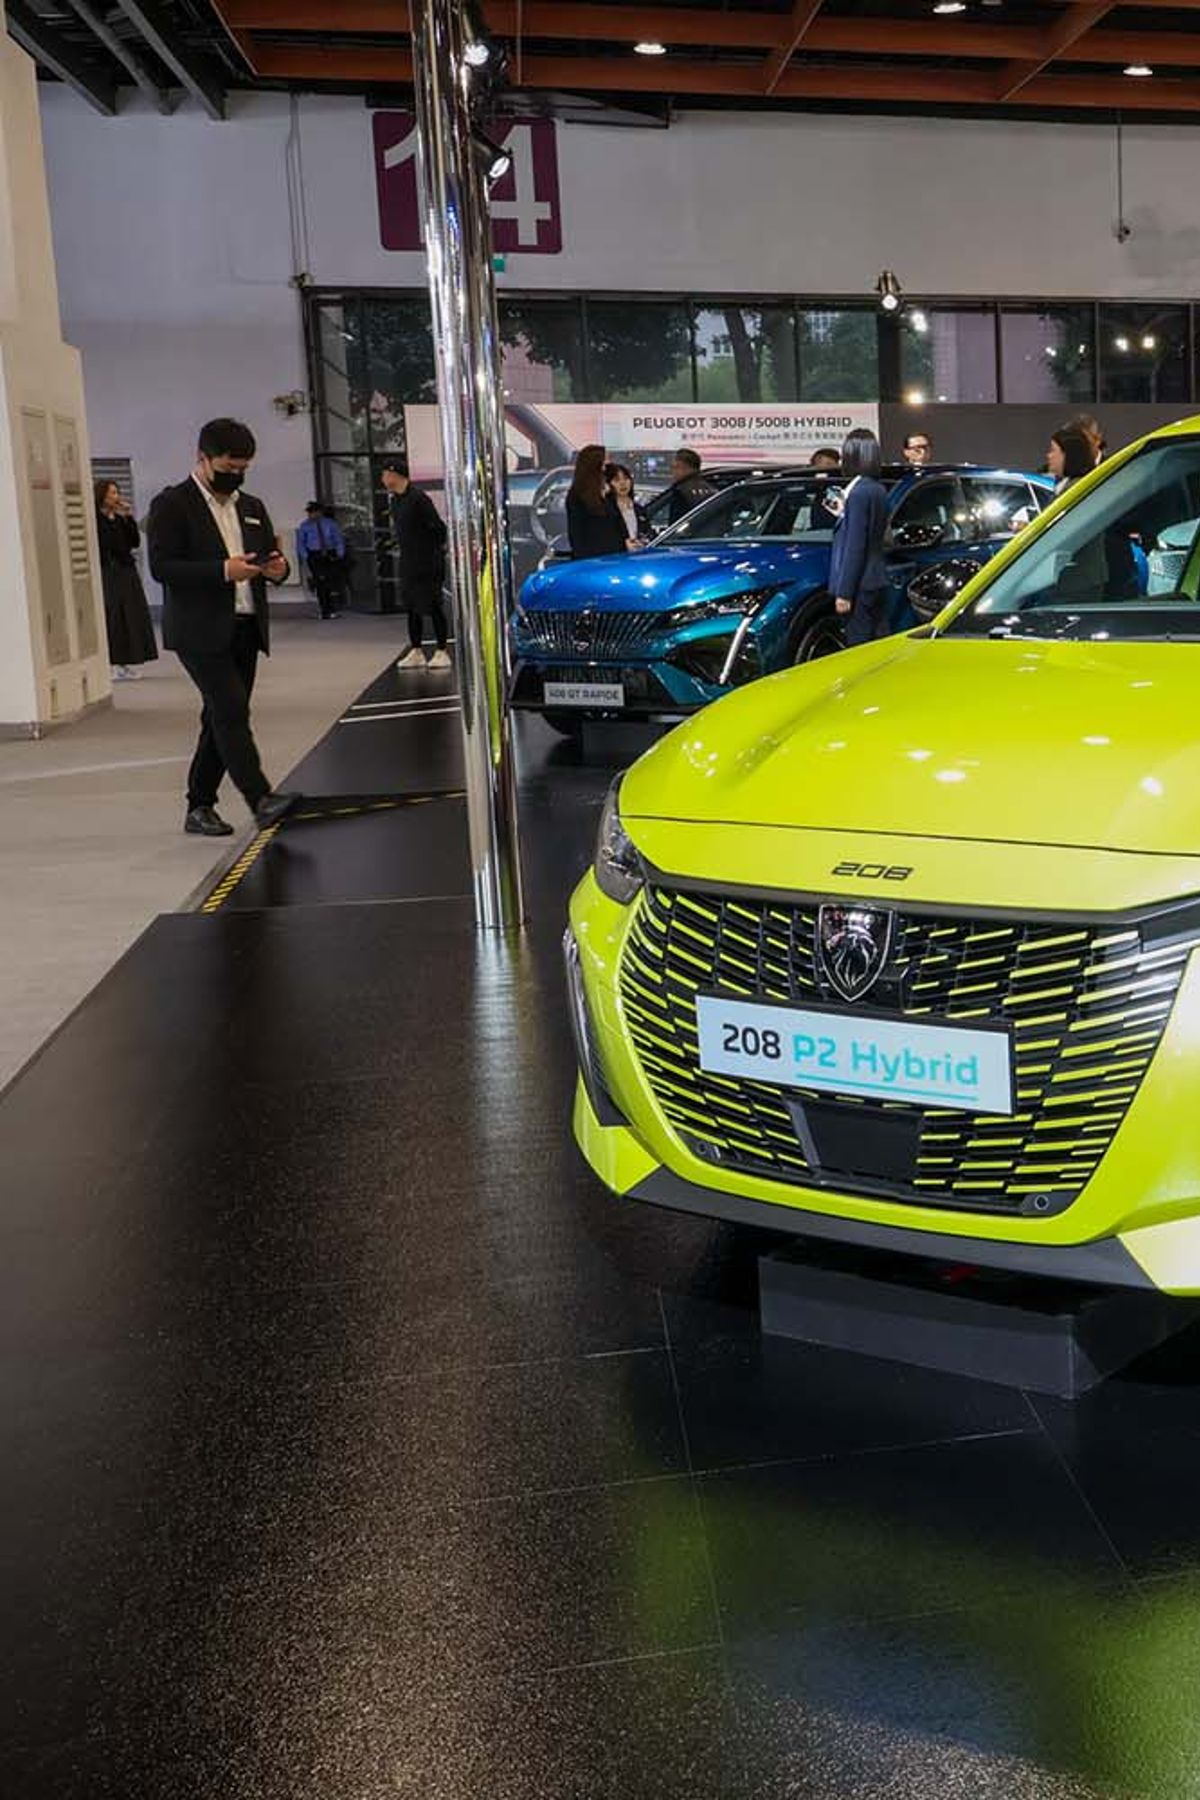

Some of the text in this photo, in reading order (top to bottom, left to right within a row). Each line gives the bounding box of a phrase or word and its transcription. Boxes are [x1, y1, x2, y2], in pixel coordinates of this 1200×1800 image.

[633, 416, 707, 429] PEUGEOT
[793, 416, 853, 428] HYBRID
[831, 861, 914, 881] 208
[721, 1023, 979, 1085] 208 P2 Hybrid
